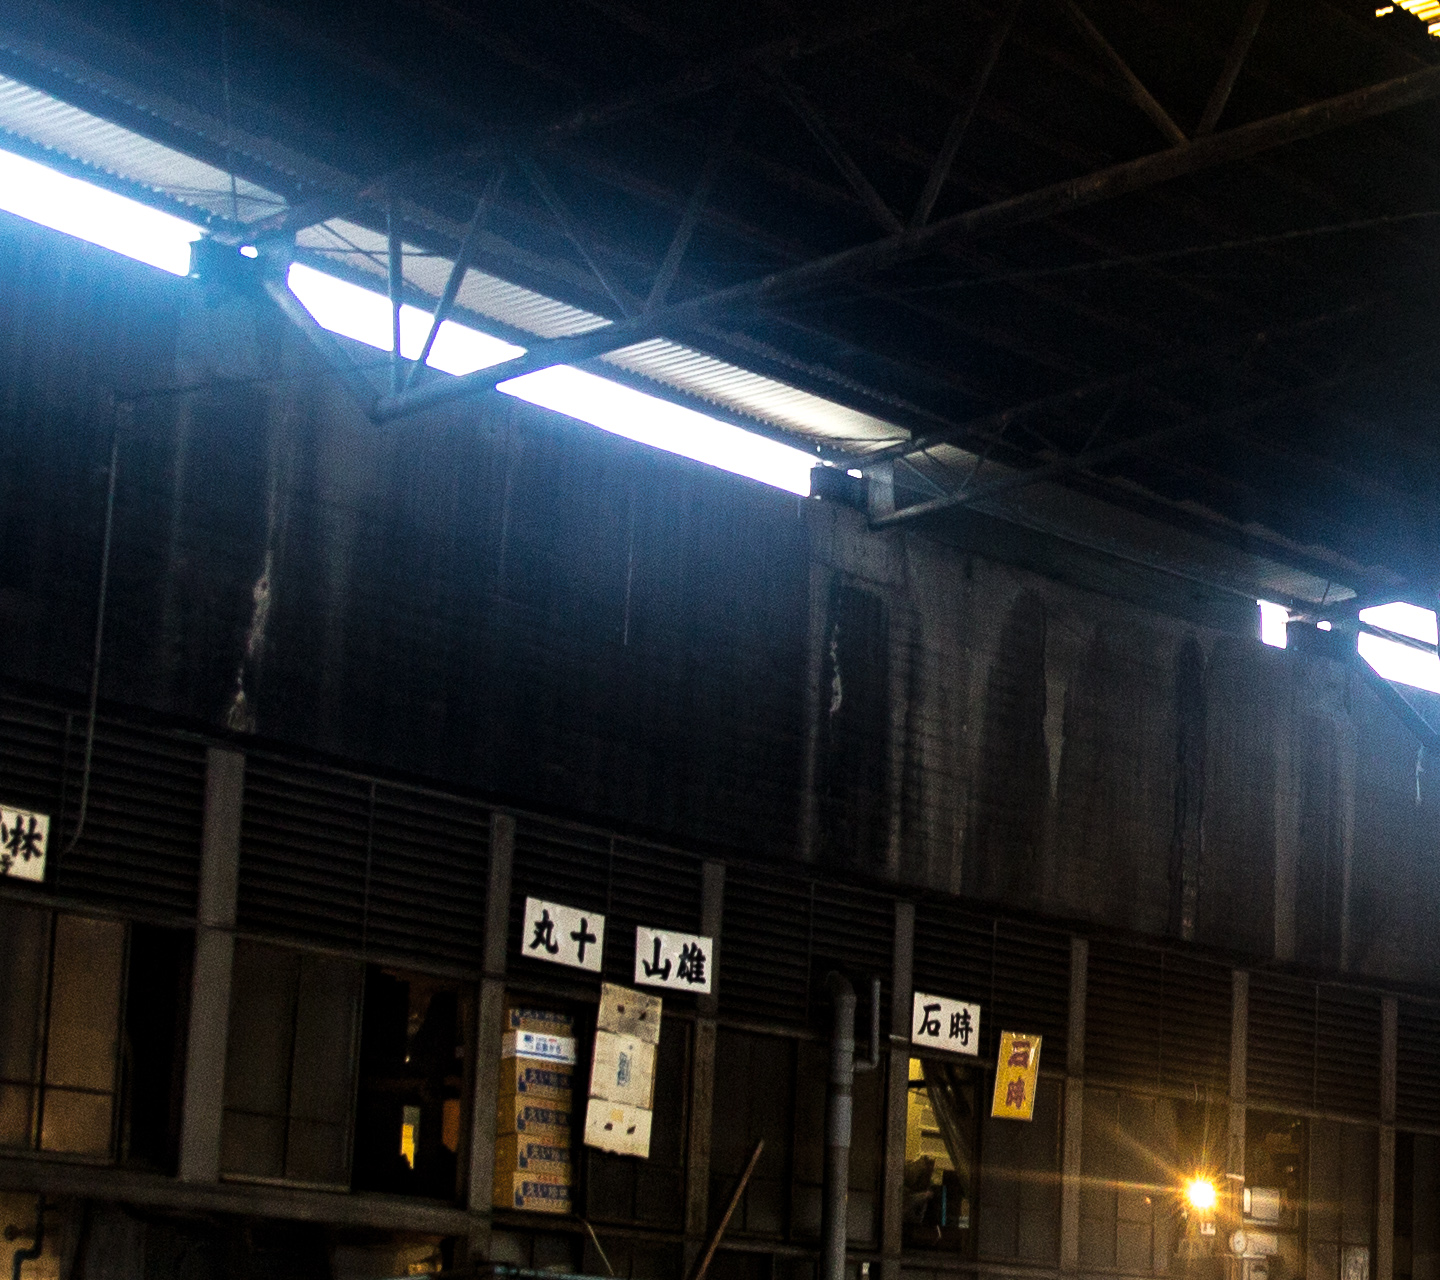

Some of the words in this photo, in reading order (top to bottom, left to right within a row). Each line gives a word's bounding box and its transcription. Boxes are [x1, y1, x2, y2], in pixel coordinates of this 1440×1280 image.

[530, 909, 596, 963] 丸十
[643, 938, 706, 983] 山雄
[918, 1003, 973, 1046] 石時
